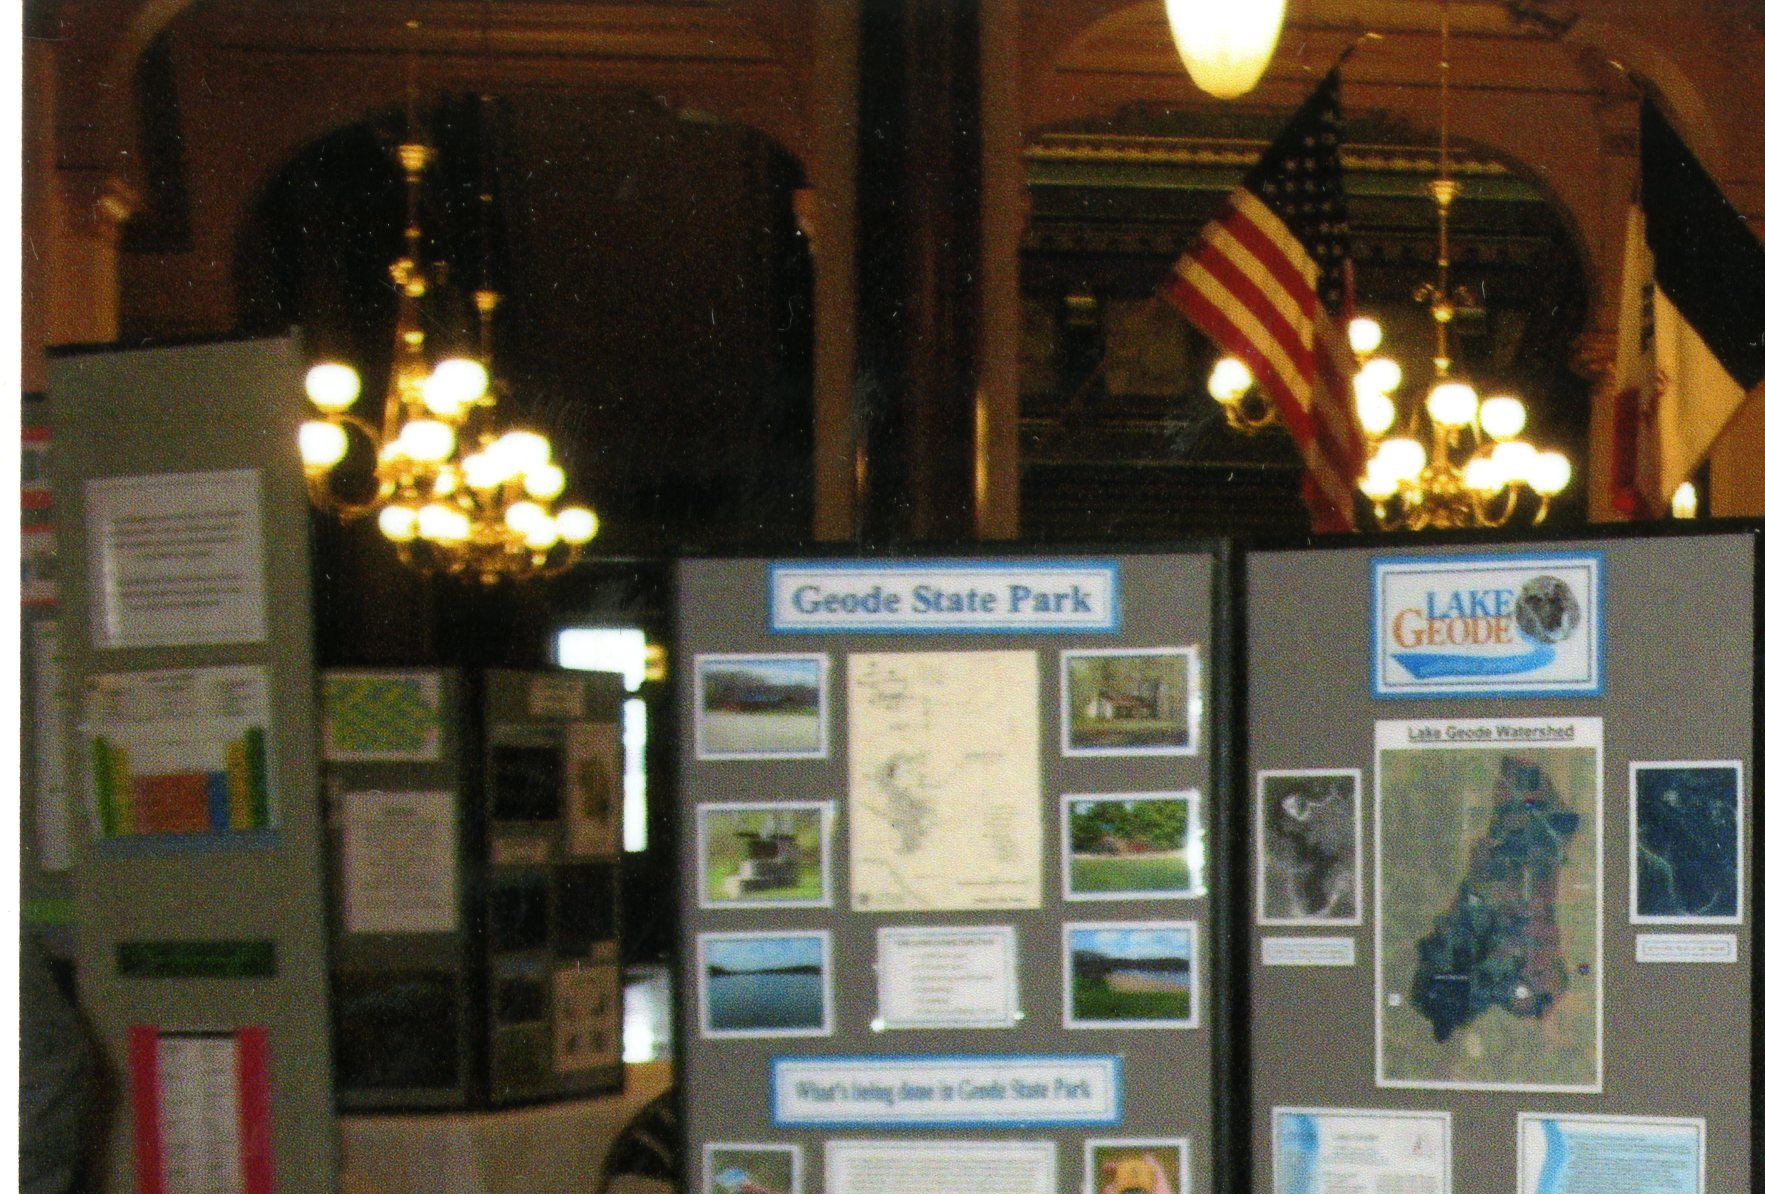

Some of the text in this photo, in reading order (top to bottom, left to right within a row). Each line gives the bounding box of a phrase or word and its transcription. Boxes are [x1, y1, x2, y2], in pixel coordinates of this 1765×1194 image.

[792, 584, 1092, 614] Geode State Park
[1426, 589, 1515, 619] LAKE
[1408, 724, 1575, 740] Lake Geode Watershed
